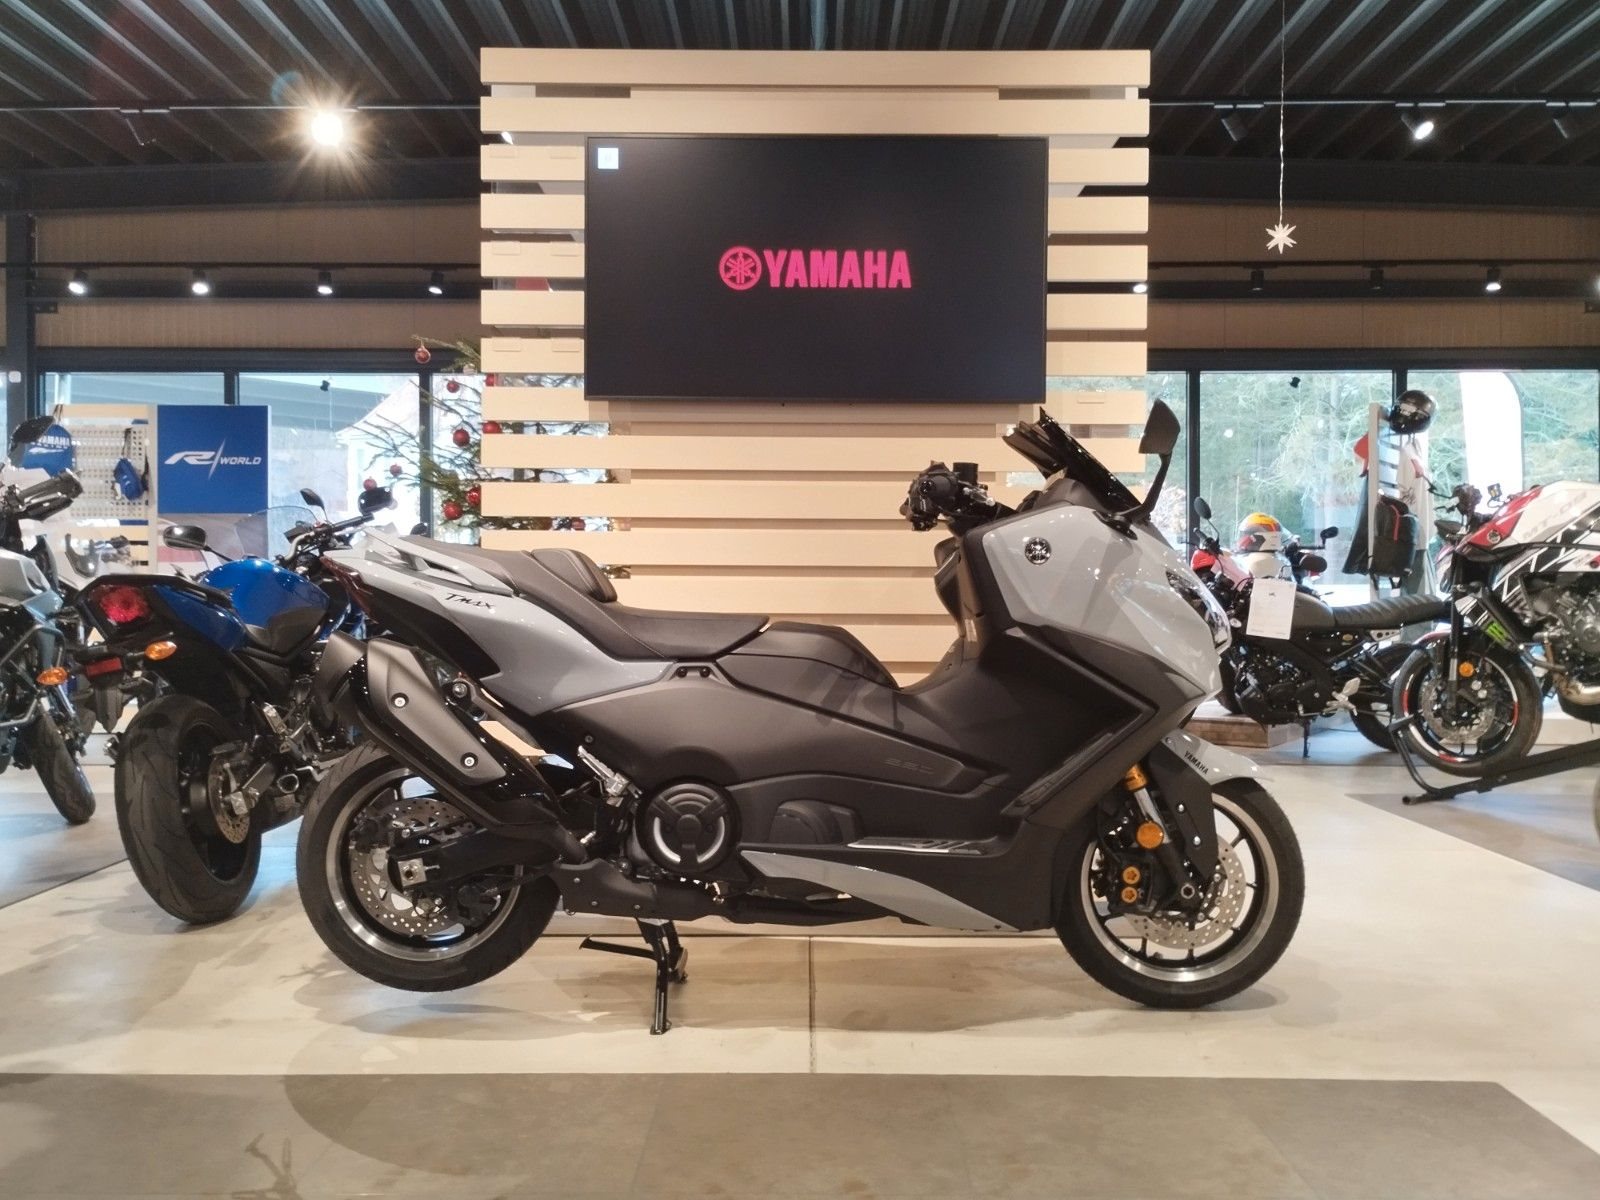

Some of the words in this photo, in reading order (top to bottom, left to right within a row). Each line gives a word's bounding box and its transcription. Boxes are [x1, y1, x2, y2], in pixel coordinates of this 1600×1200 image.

[763, 249, 912, 288] YAMAHA
[220, 456, 262, 465] WORLD
[445, 592, 495, 609] TMAX
[1184, 750, 1209, 775] YAMAHA
